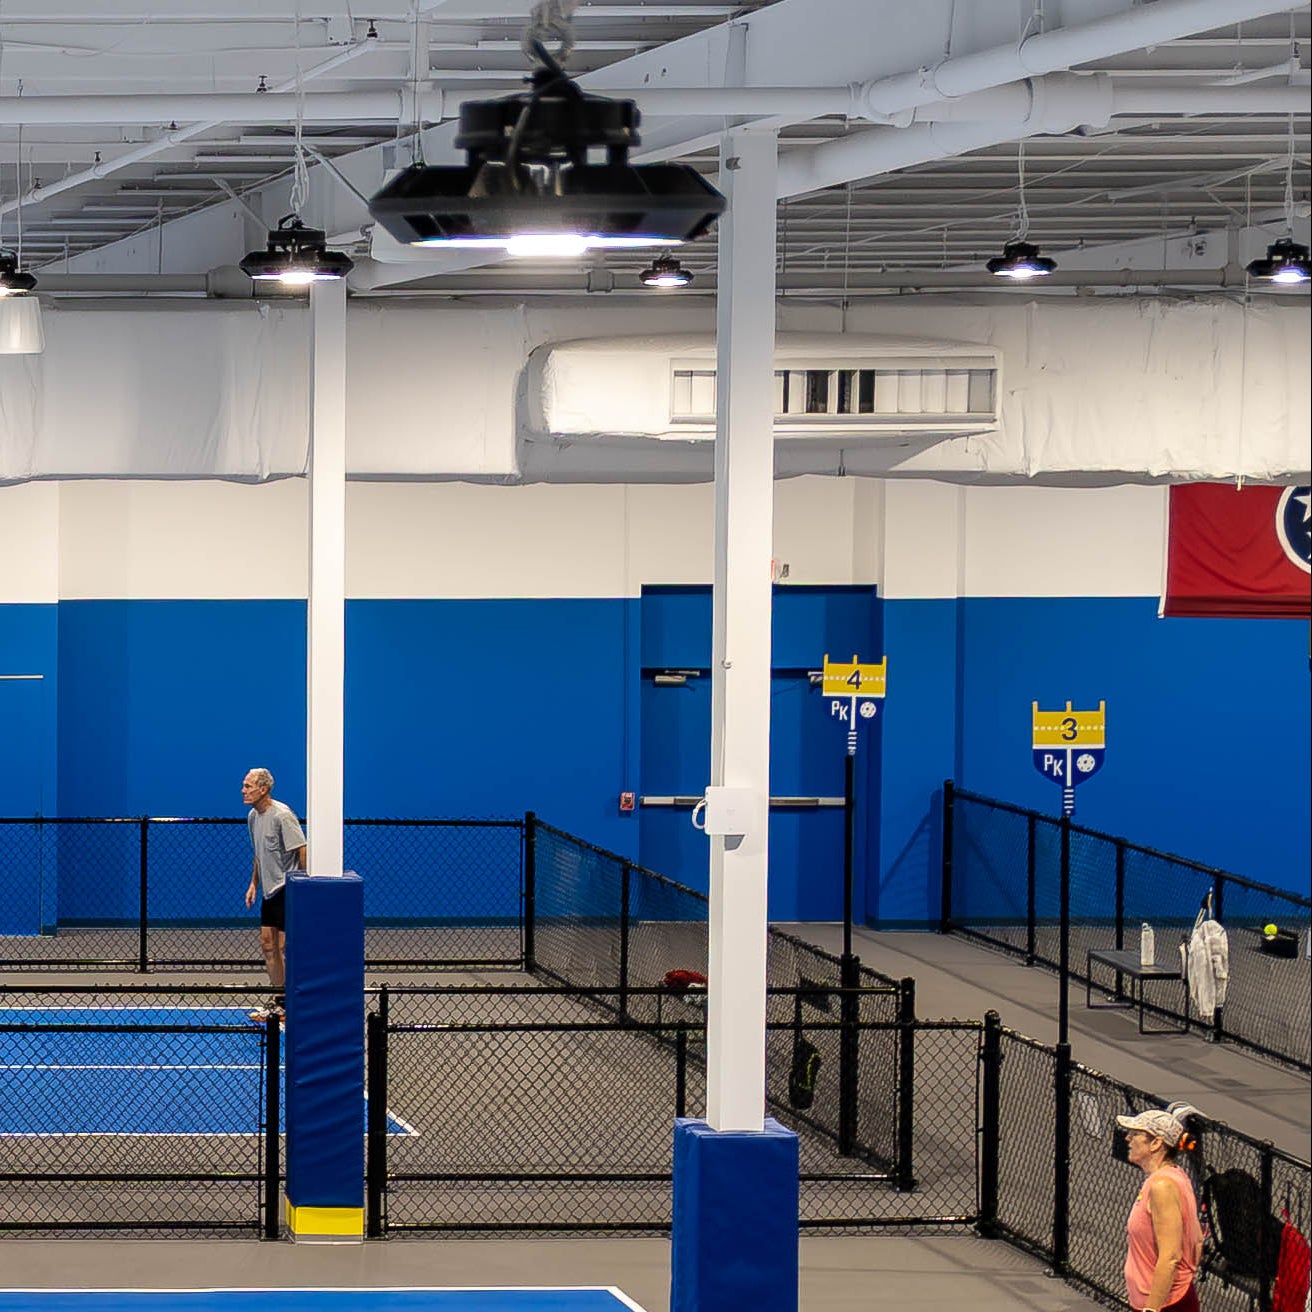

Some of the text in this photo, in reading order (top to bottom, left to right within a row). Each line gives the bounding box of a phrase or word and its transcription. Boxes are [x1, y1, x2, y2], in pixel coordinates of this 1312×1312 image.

[846, 669, 862, 690] 4
[831, 700, 848, 721] PK
[1061, 717, 1078, 741] 3
[1044, 754, 1063, 776] PK
